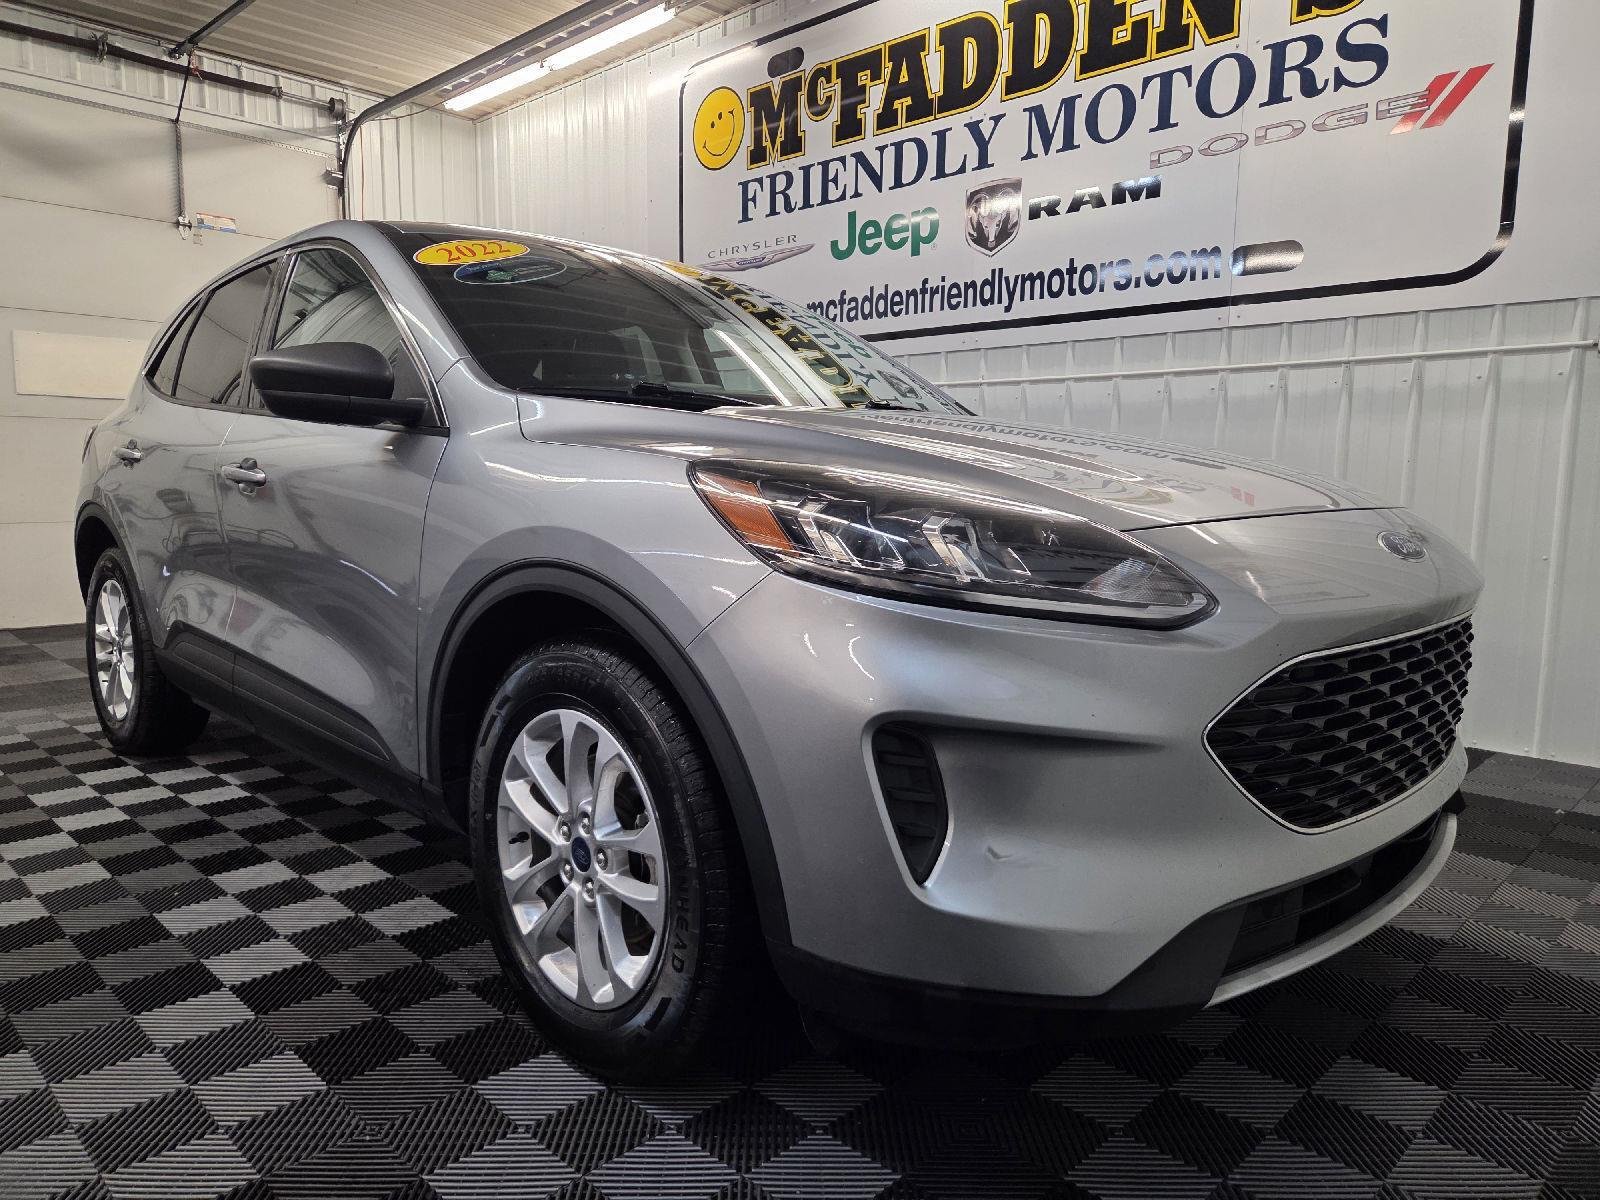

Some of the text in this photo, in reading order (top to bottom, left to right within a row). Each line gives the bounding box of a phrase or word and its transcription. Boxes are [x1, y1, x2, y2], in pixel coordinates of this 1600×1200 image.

[737, 13, 1389, 225] FRIENDLY MOTORS
[1149, 88, 1431, 170] DODGE
[1028, 174, 1162, 221] RAM
[435, 240, 511, 263] 2022
[707, 234, 798, 260] CHRYSLER
[830, 206, 940, 261] Jeep
